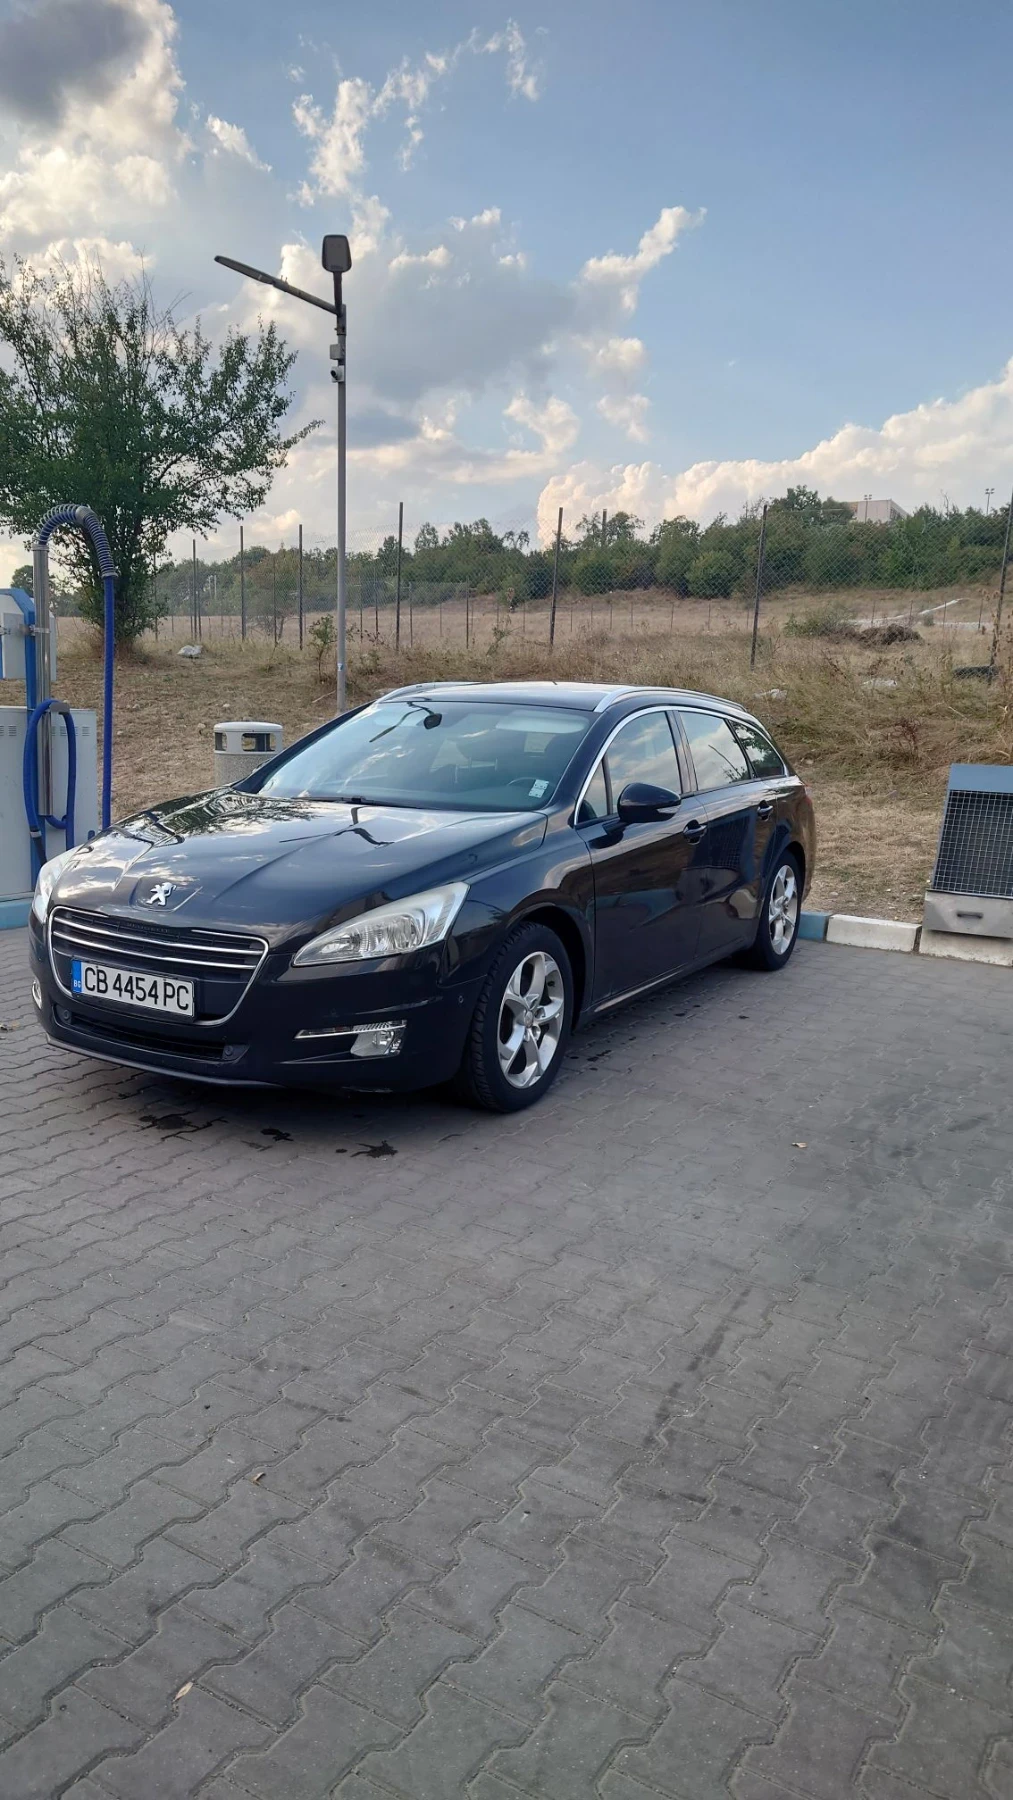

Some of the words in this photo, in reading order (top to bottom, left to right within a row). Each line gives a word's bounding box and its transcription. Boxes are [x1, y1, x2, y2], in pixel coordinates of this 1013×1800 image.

[73, 979, 81, 988] BG
[84, 967, 109, 994] CB
[112, 973, 159, 1005] 4454
[163, 981, 189, 1011] PC
